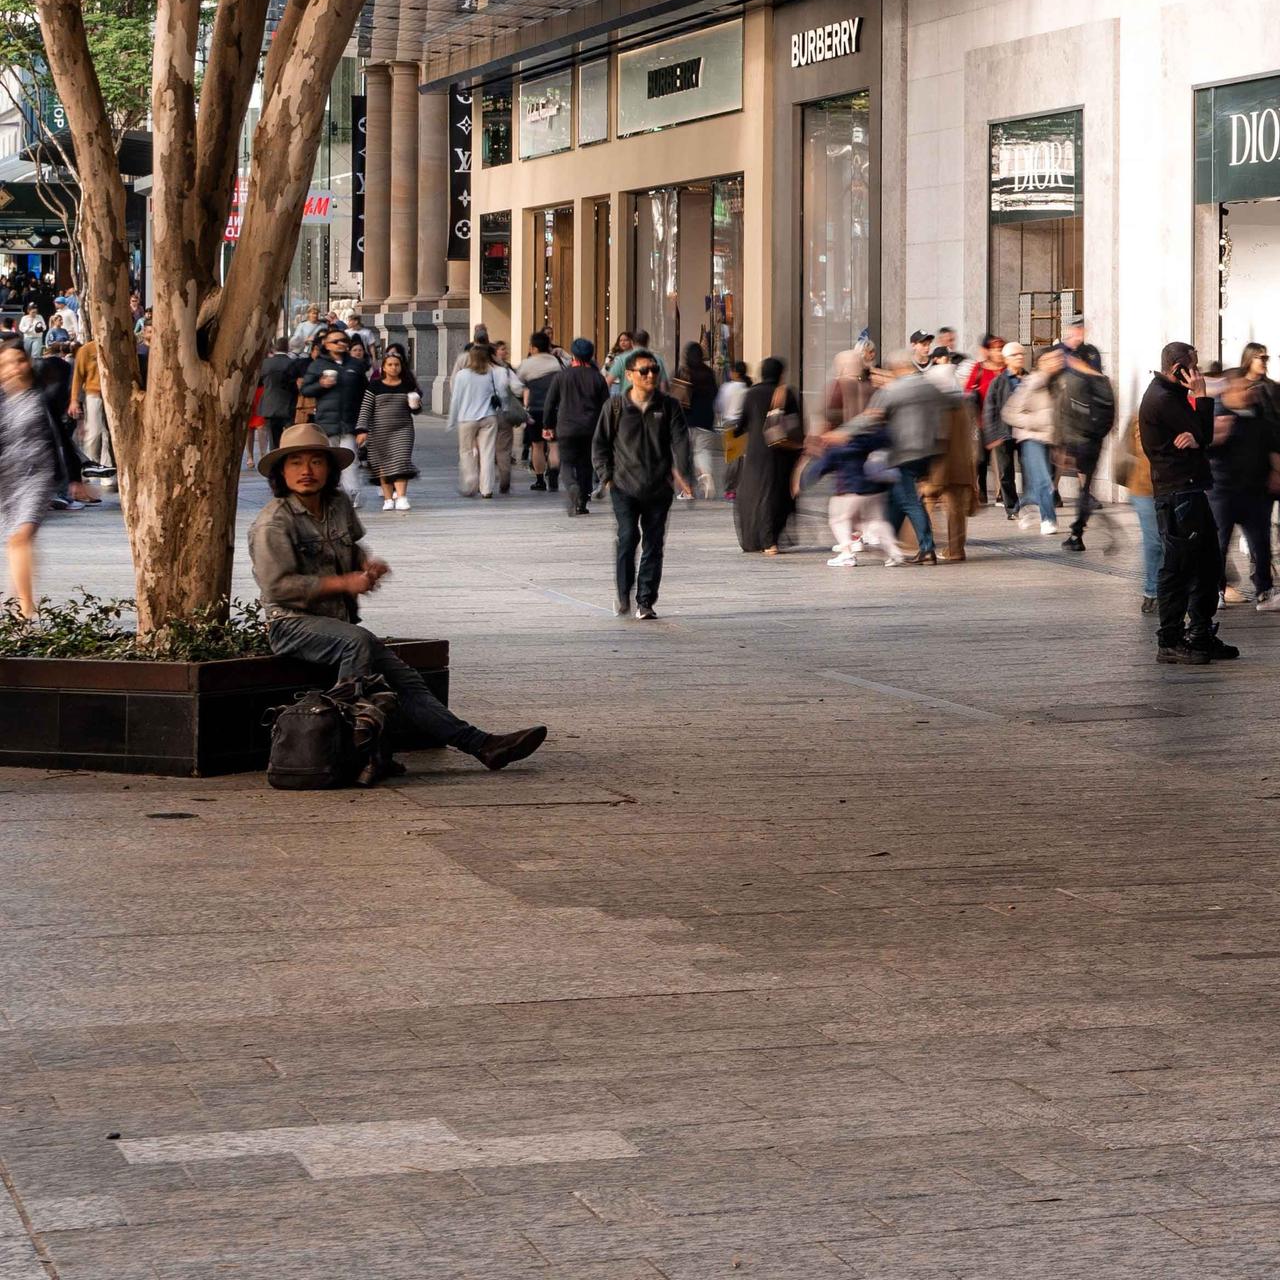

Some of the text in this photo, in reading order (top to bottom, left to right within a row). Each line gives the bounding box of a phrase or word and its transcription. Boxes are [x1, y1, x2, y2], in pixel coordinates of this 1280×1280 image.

[791, 16, 861, 68] BURBERRY
[647, 56, 703, 100] BURBERRY
[1013, 142, 1063, 193] DIOR
